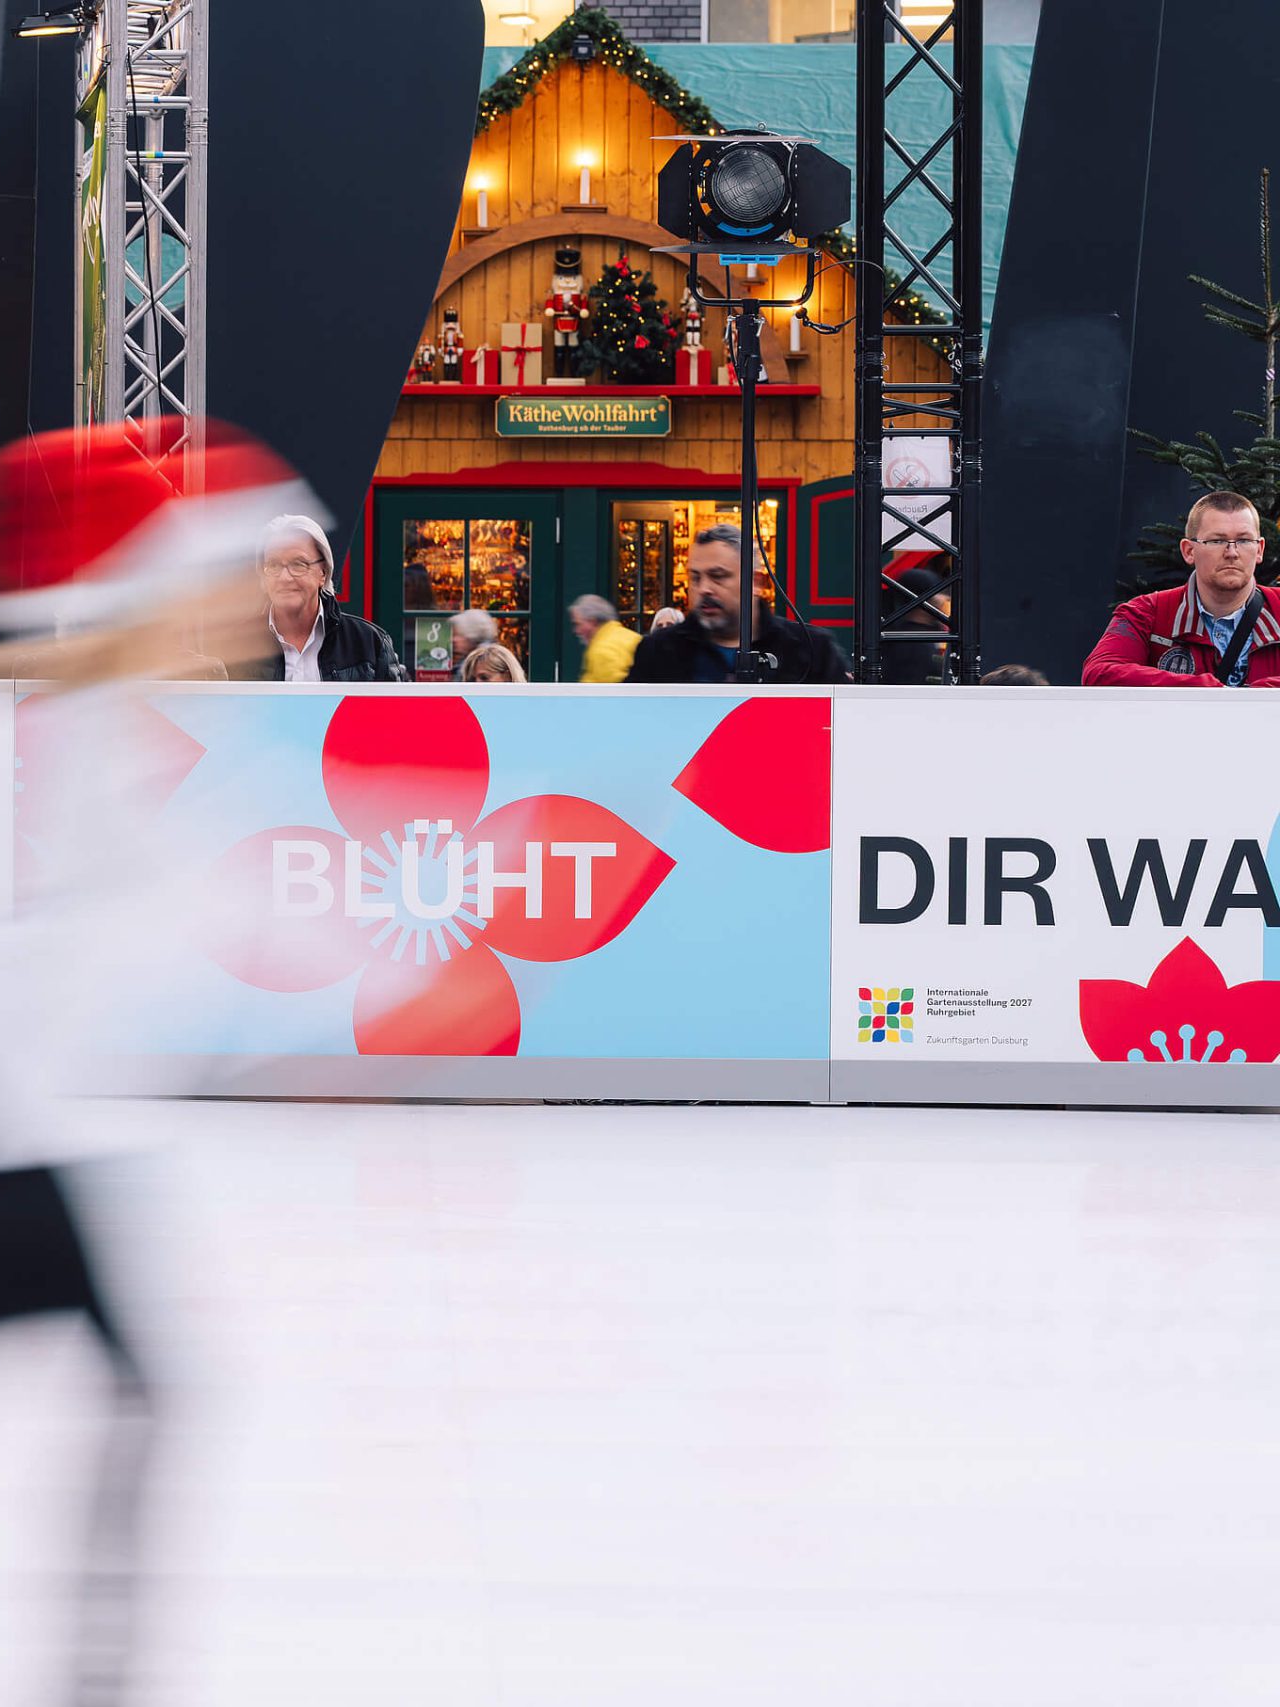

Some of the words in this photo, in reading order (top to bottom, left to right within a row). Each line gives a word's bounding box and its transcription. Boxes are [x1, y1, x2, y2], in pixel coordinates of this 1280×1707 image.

[508, 403, 562, 422] Käthe
[561, 403, 658, 422] Wohlfahrt
[427, 622, 441, 643] 8
[272, 819, 617, 920] BLÜHT
[859, 836, 1057, 926] DIR
[1086, 838, 1280, 928] WA
[927, 988, 989, 996] Internationale
[927, 998, 1008, 1008] Gartenausstellung
[1010, 999, 1033, 1007] 2027
[927, 1008, 976, 1017] Ruhrgebiet
[926, 1035, 989, 1045] Zukunftsgarten
[991, 1036, 1029, 1046] Duisburg
